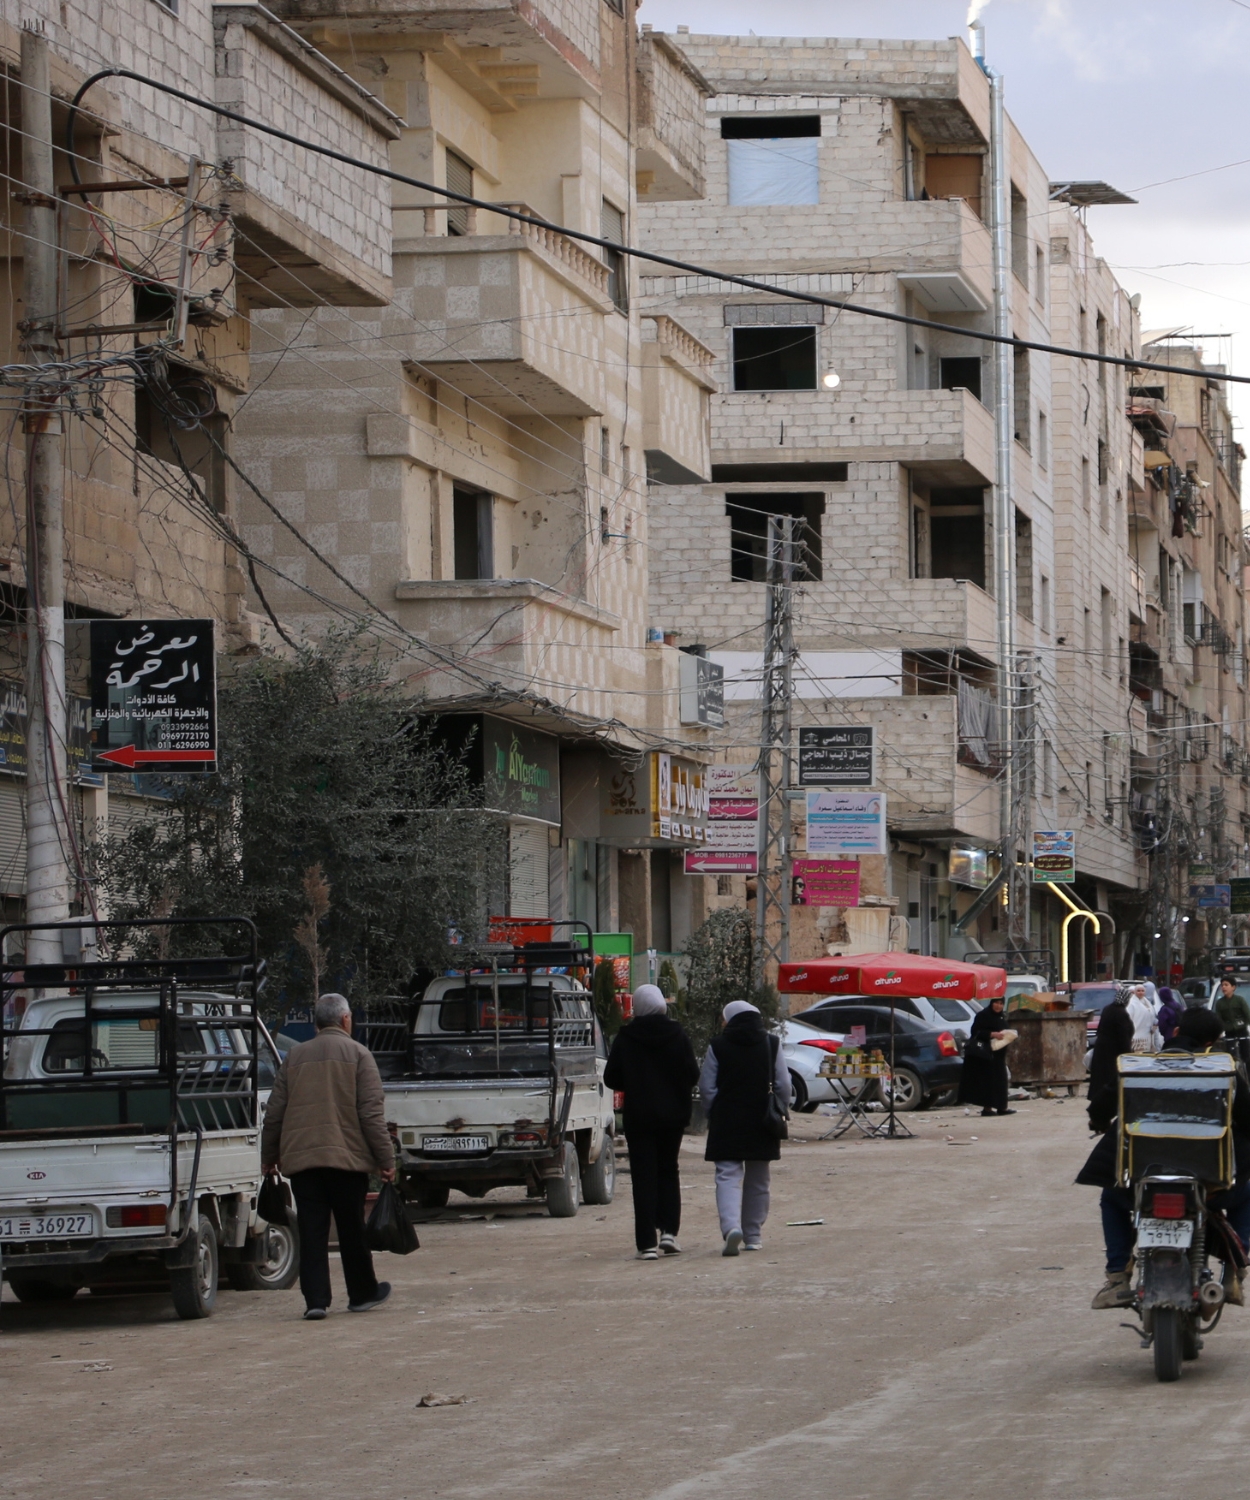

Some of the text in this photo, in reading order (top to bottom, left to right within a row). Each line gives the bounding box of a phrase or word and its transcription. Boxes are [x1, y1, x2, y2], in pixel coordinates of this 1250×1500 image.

[116, 624, 198, 656] معرض
[106, 658, 200, 690] الرحمة
[126, 694, 176, 706] كافة الأدوات
[95, 708, 210, 721] والأجهزة الكهربائية والمنزلية
[161, 732, 210, 740] 0969772170
[822, 734, 850, 746] المحامي
[158, 741, 210, 749] 011-6296990
[849, 750, 871, 760] جمال
[711, 769, 736, 780] الدكتورة
[0, 1216, 86, 1236] 1 36927
